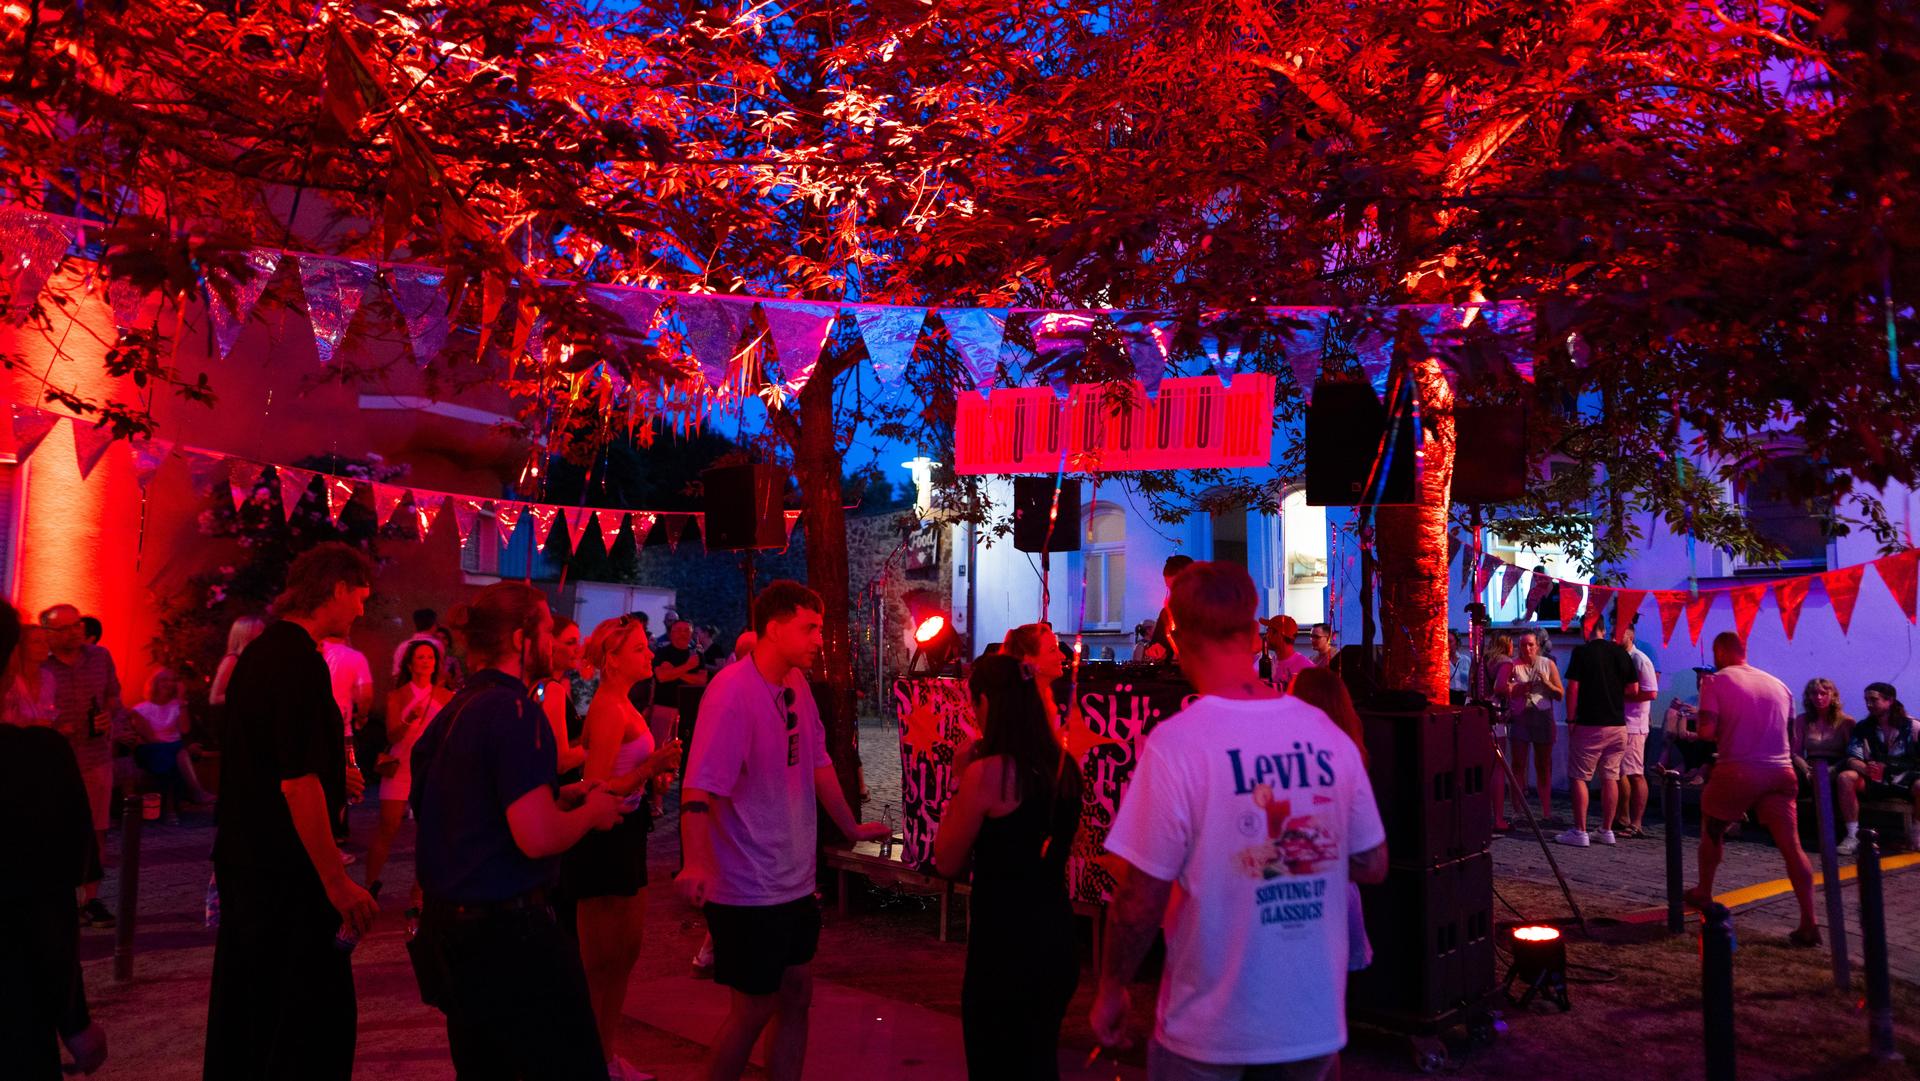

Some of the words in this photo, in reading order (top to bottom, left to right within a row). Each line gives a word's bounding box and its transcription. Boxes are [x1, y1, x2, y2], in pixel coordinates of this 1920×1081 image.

[1226, 741, 1335, 795] Levi's
[1256, 881, 1312, 906] SERVING
[1261, 901, 1323, 925] CLASSICS
